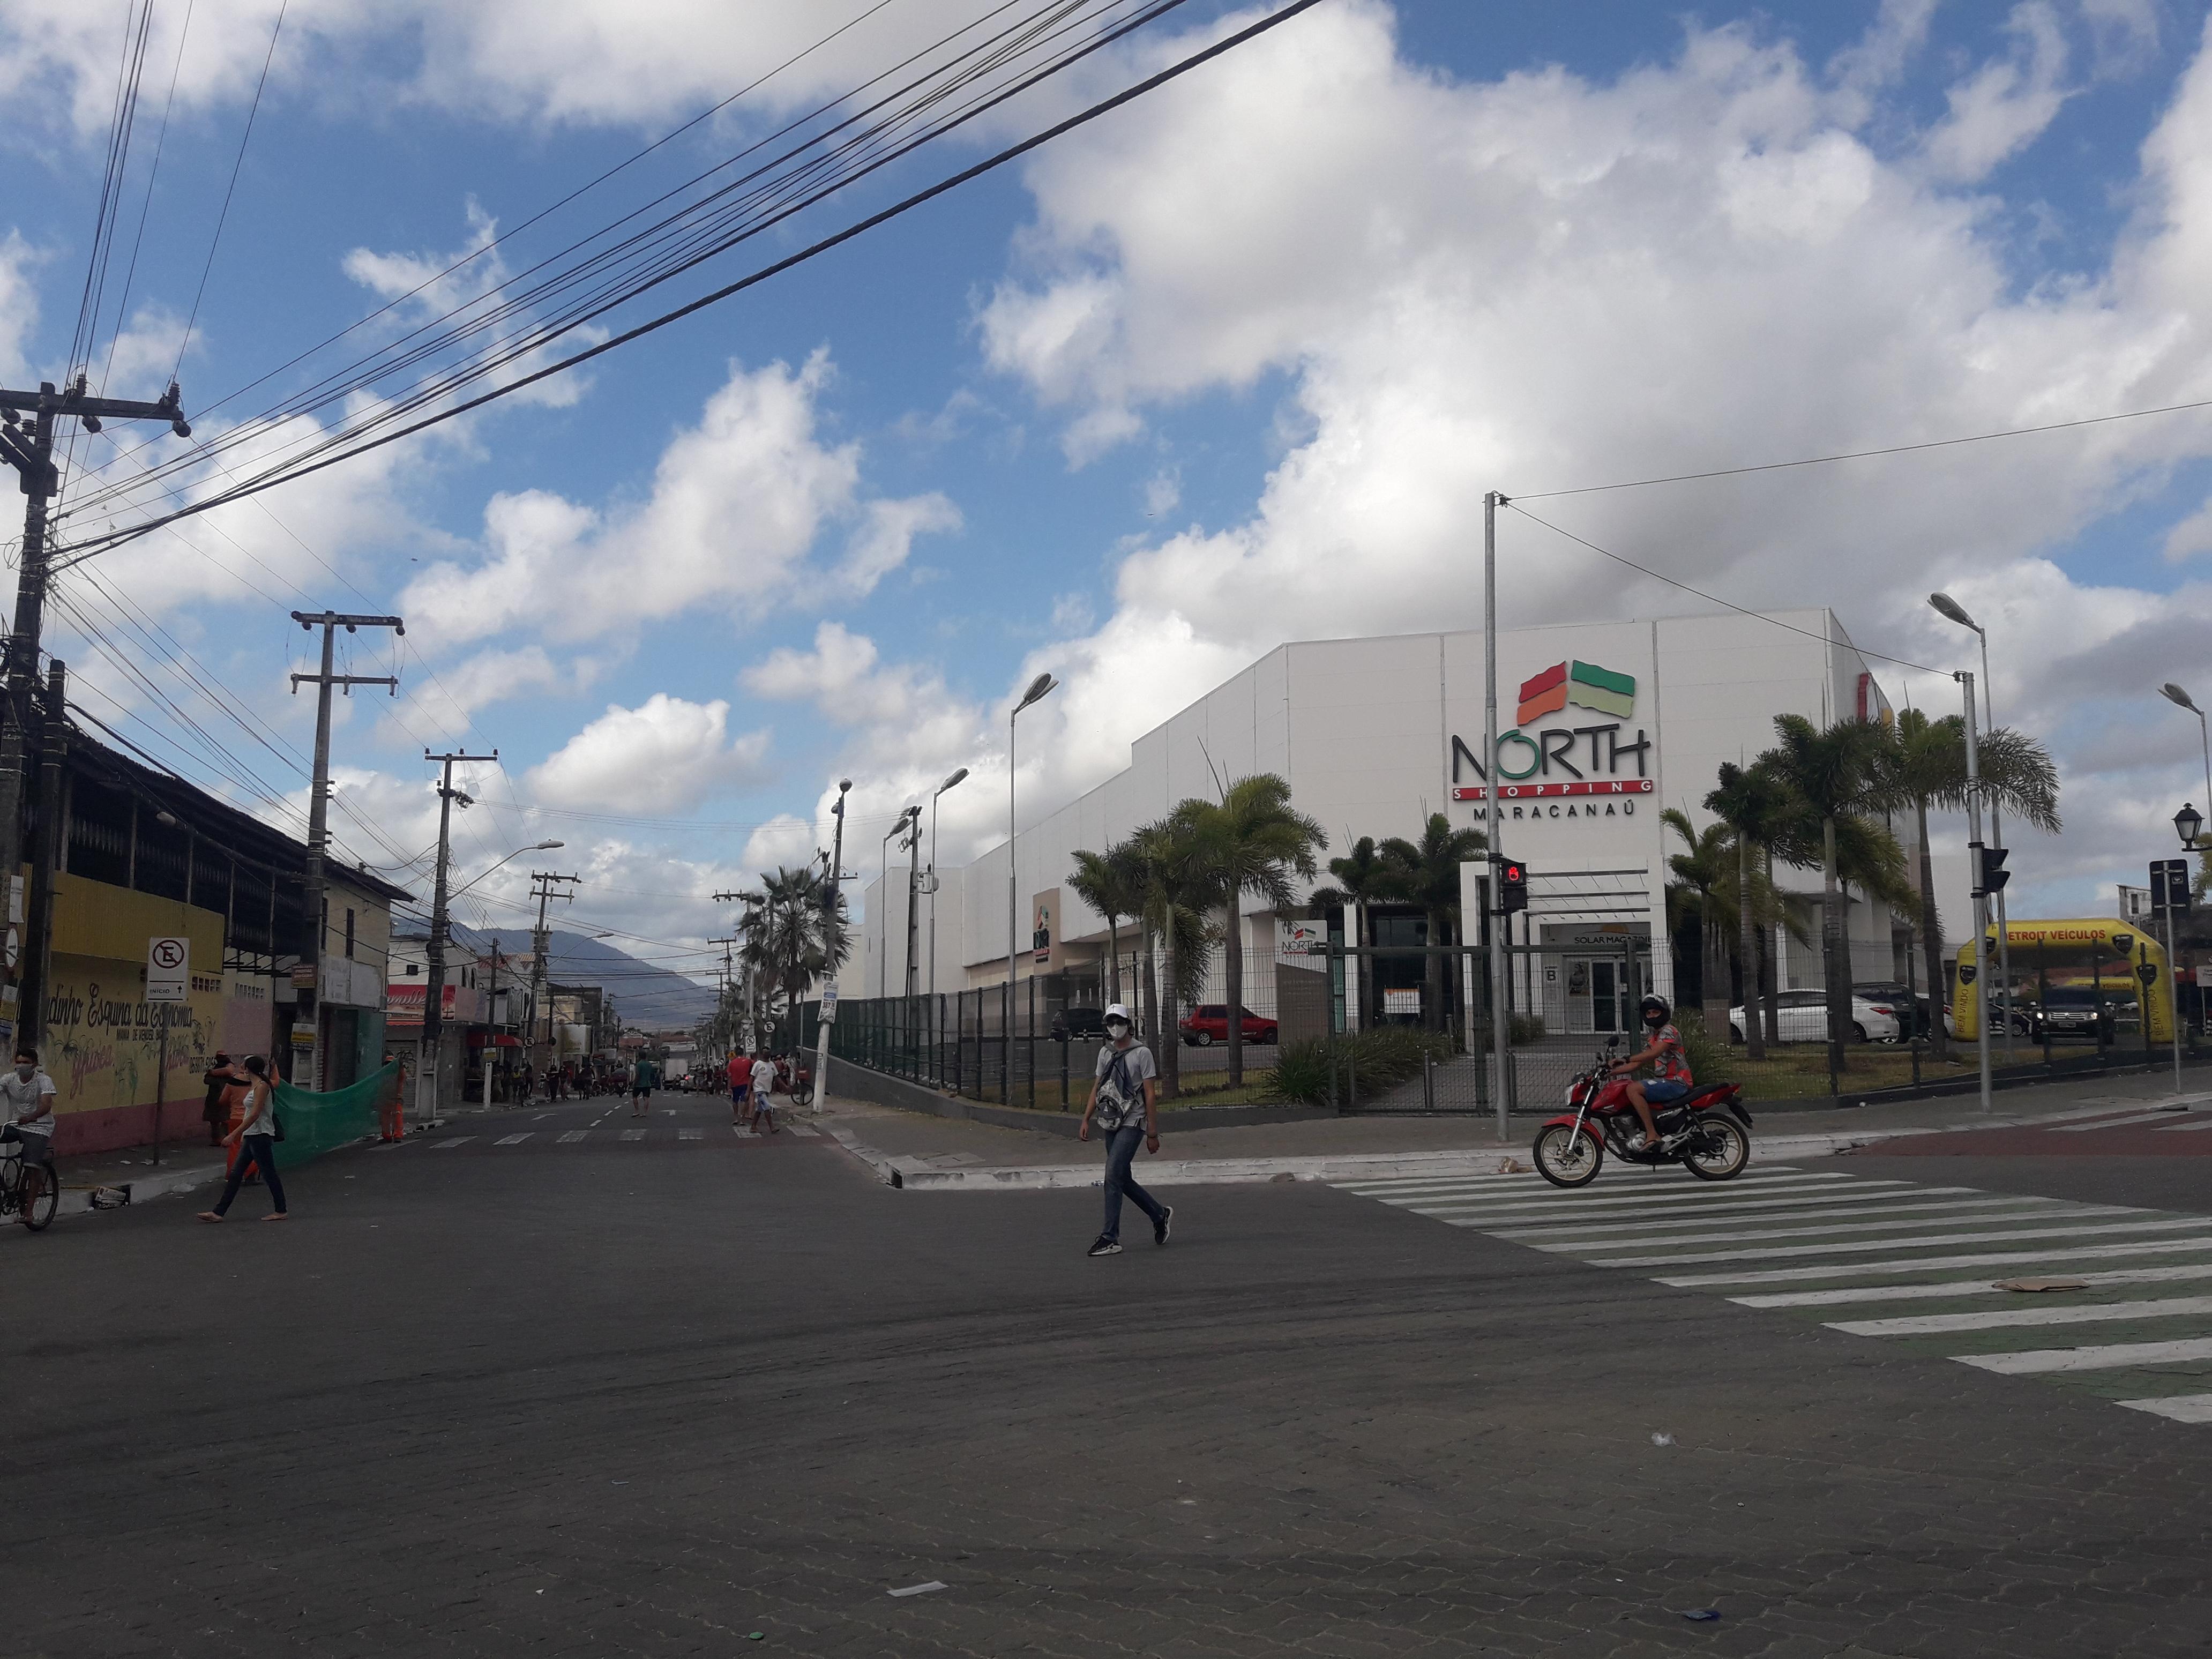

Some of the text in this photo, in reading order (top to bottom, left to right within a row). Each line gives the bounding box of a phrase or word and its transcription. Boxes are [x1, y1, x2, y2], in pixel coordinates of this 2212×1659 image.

[1452, 723, 1651, 783] NORTH
[1454, 780, 1651, 799] SHOPPING
[1474, 799, 1633, 820] MARACANAÚ
[2006, 929, 2106, 940] ETROIT VEÍCULOS
[1548, 970, 1556, 981] B
